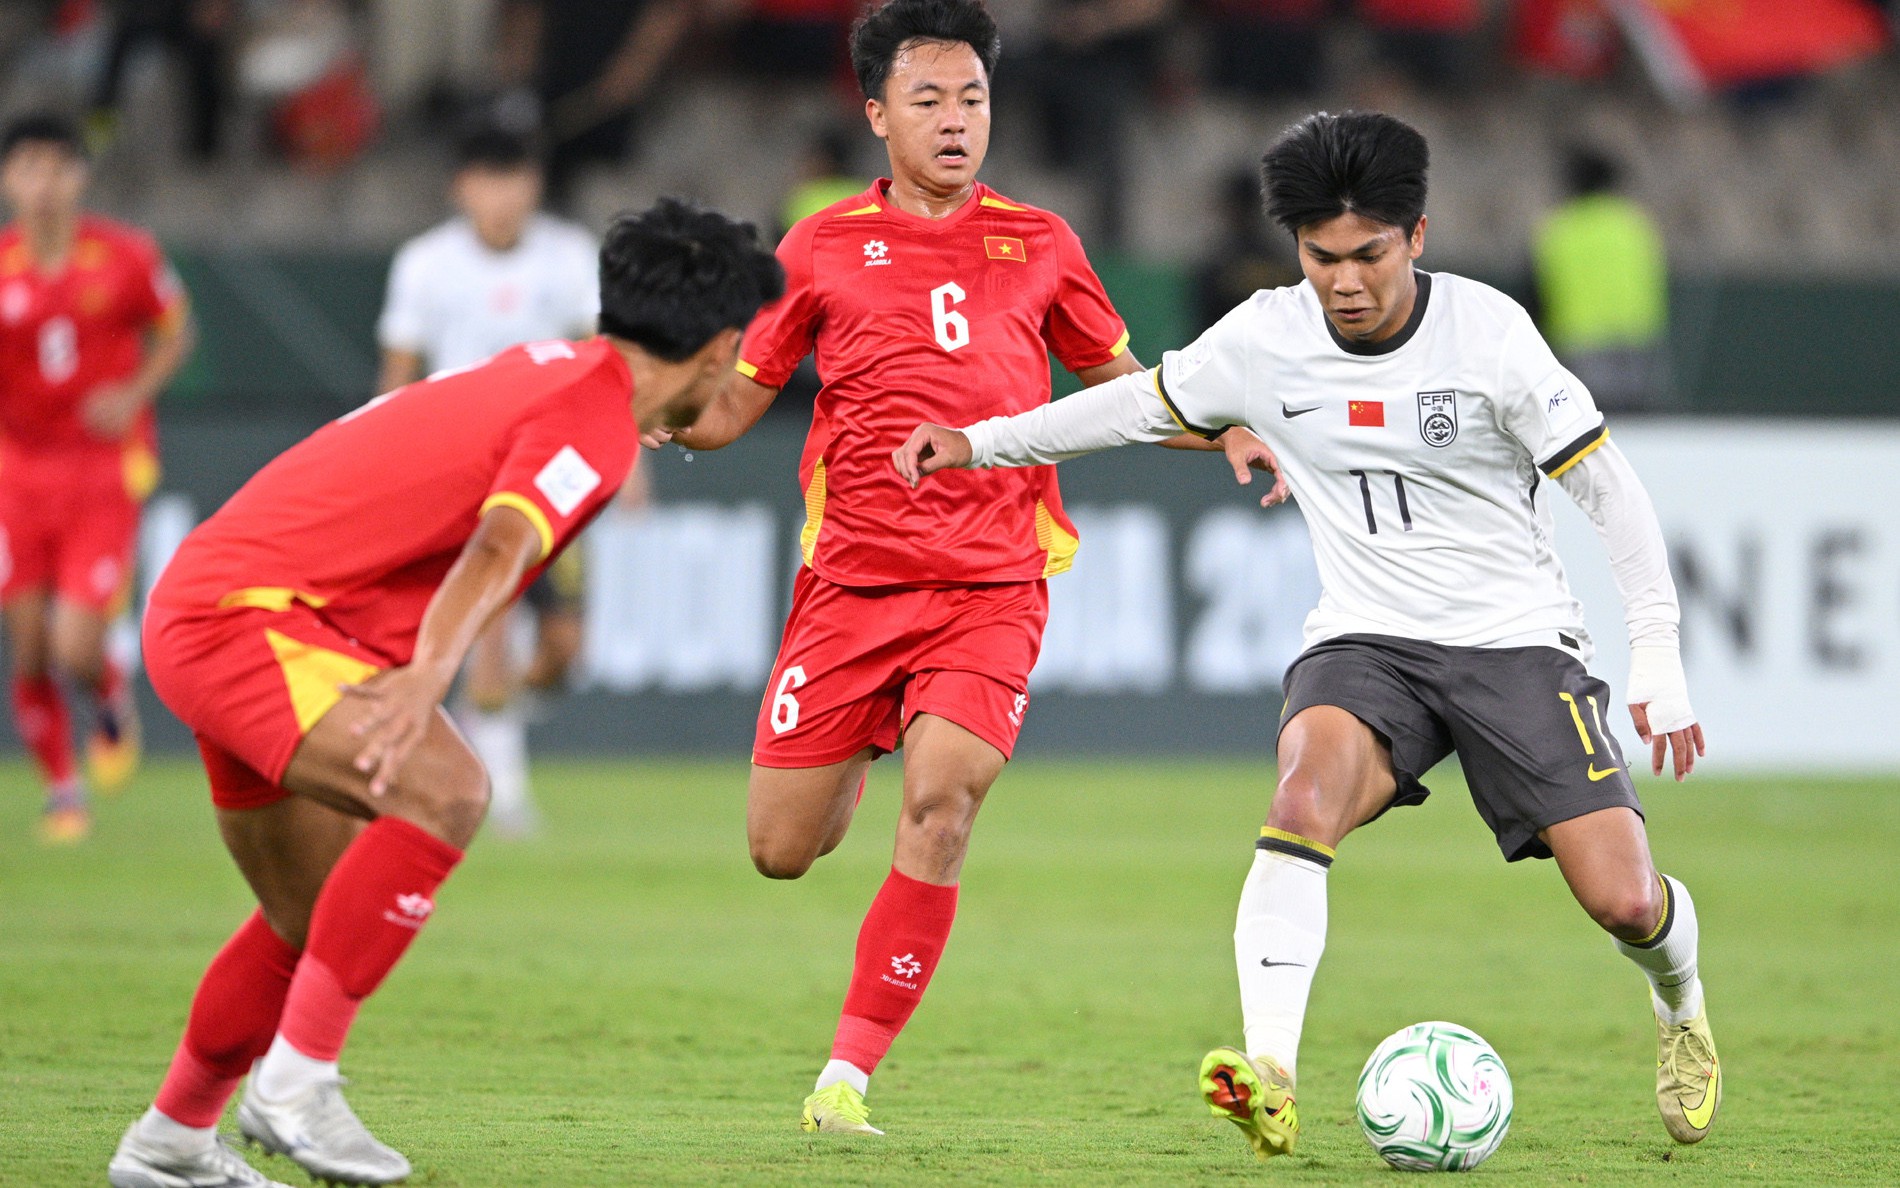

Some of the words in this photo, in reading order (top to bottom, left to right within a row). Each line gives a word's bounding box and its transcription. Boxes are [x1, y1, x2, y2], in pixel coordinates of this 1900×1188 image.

[930, 281, 970, 353] 6
[1421, 394, 1453, 406] CFA
[1548, 388, 1568, 414] AFC
[1349, 469, 1413, 535] 11
[770, 665, 808, 735] 6
[1558, 692, 1617, 760] 11
